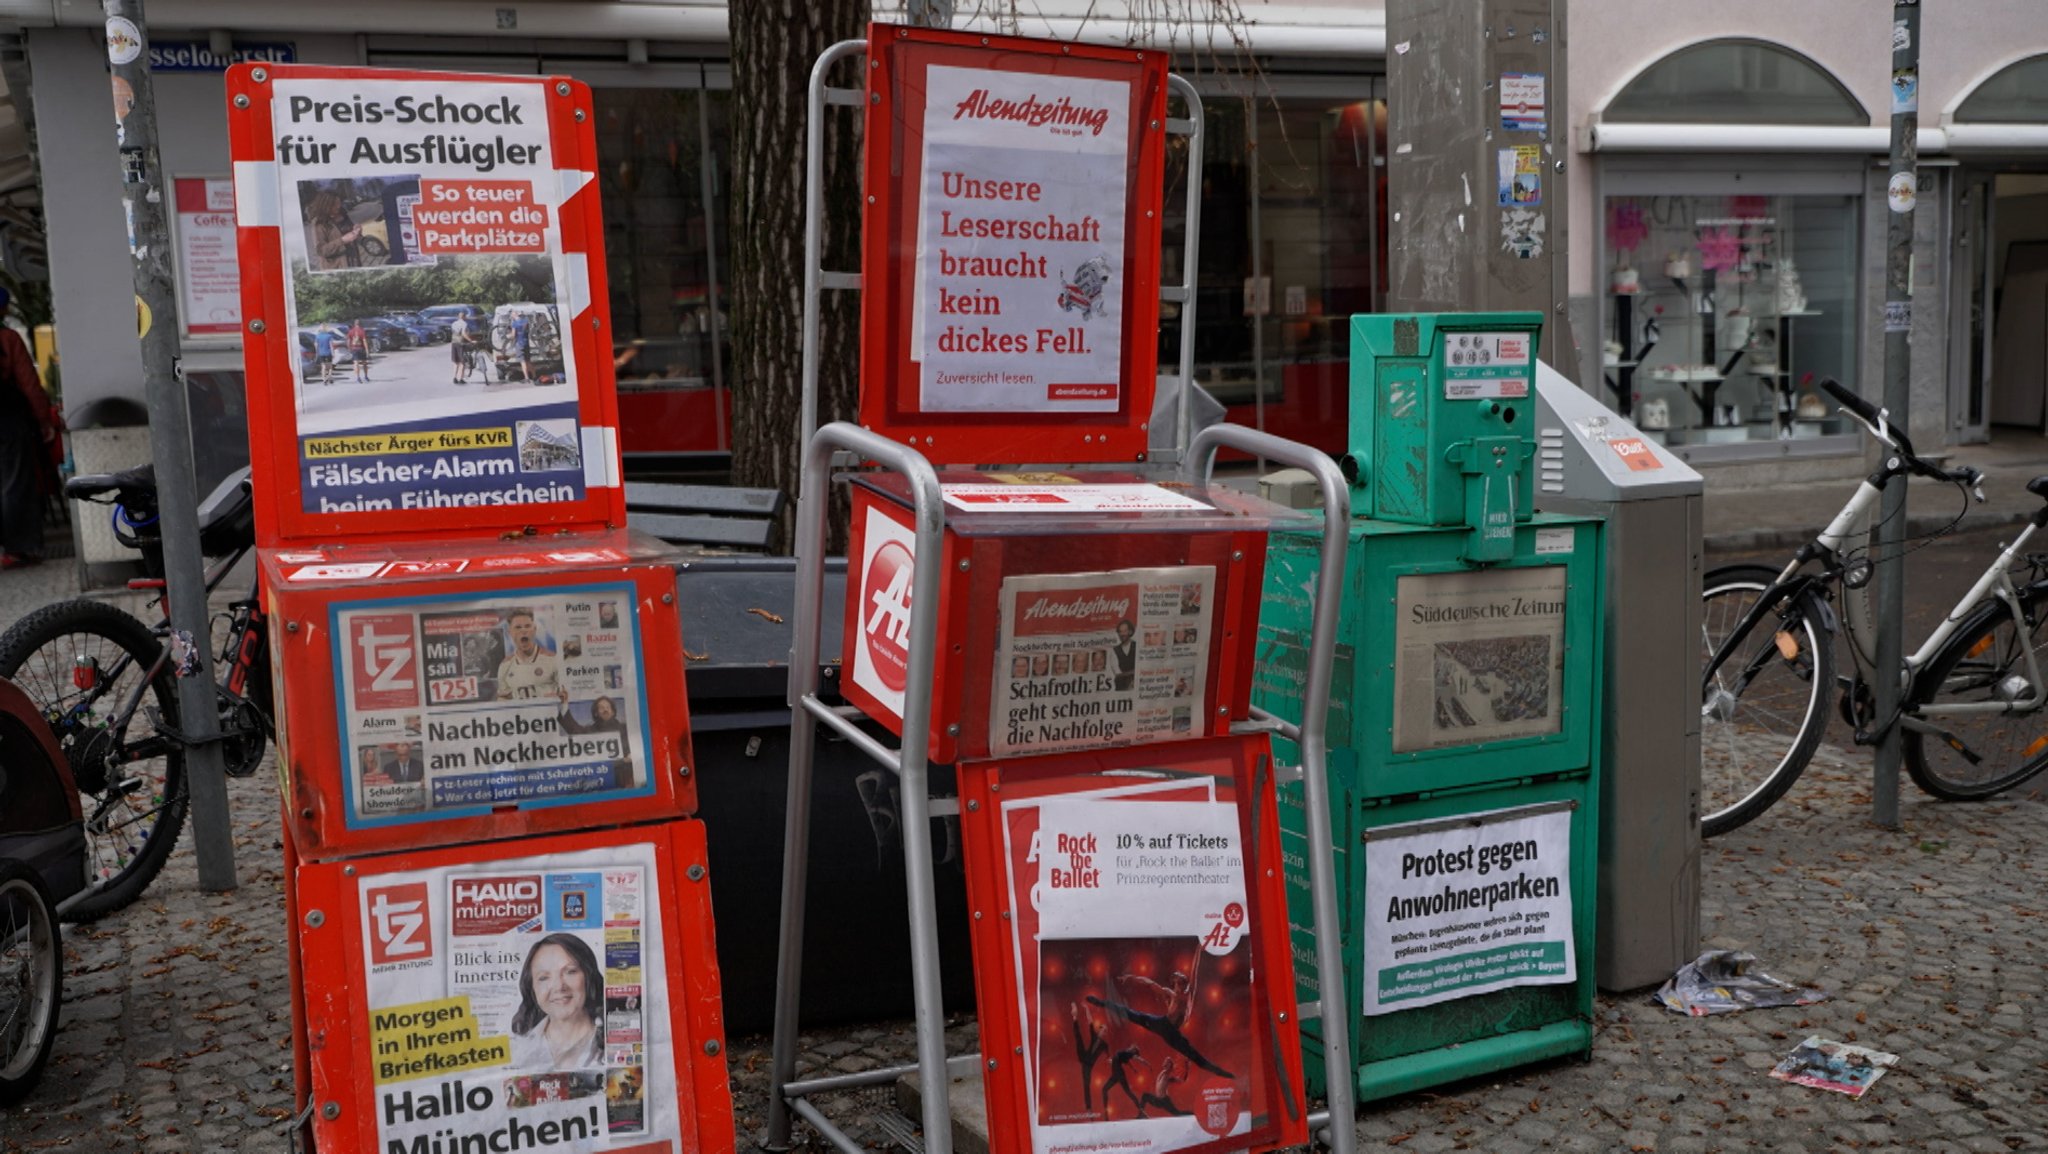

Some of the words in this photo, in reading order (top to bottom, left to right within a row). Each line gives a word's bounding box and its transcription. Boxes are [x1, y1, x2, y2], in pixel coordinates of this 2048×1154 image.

[290, 94, 524, 125] Preis-Schock
[953, 89, 1109, 136] Abendzeitung
[277, 134, 337, 166] für
[350, 134, 541, 172] Ausflügler
[432, 185, 460, 202] So
[465, 186, 525, 202] teuer
[942, 172, 1041, 201] Unsere
[418, 207, 503, 225] werden
[510, 205, 542, 225] die
[941, 211, 1100, 242] Leserschaft
[425, 229, 541, 251] Parkplätze
[939, 248, 1047, 279] braucht
[939, 288, 1001, 315] kein
[938, 326, 1028, 354] dickes
[1035, 327, 1091, 354] Fell.
[936, 371, 998, 385] Zuversicht
[1002, 371, 1036, 385] lesen.
[309, 439, 383, 456] Nächster
[388, 435, 433, 451] Ärger
[439, 433, 470, 447] fürs
[475, 431, 508, 445] KVR
[309, 455, 514, 487] Fälscher-Alarm
[320, 494, 392, 514] beim
[402, 481, 574, 510] Führerschein
[566, 602, 591, 613] Putin
[1024, 594, 1129, 621] Abendzeitung
[1412, 602, 1510, 624] Süddeutsche
[427, 642, 458, 659] Mia
[586, 634, 617, 643] Razzia
[1063, 640, 1075, 649] mit
[358, 624, 414, 691] tz
[428, 662, 457, 676] san
[566, 665, 600, 676] Parken
[431, 677, 477, 700] 125!
[1010, 676, 1092, 700] Schafroth:
[1096, 674, 1112, 691] Es
[363, 717, 396, 728] Alarm
[1008, 702, 1047, 728] geht
[1052, 700, 1100, 719] schon
[1106, 699, 1133, 713] um
[428, 715, 557, 742] Nachbeben
[1007, 726, 1034, 745] die
[1039, 720, 1123, 742] Nachfolge
[431, 752, 466, 770] am
[474, 737, 620, 766] Nockherberg
[444, 778, 482, 789] tz-Leser
[487, 774, 524, 785] rechnen
[528, 771, 544, 781] mit
[547, 766, 593, 779] Schafroth
[597, 765, 608, 774] ab
[475, 789, 492, 800] das
[494, 786, 517, 799] jetzt
[520, 784, 533, 795] für
[537, 782, 555, 793] den
[1058, 832, 1096, 853] Rock
[1149, 833, 1172, 849] auf
[1176, 833, 1228, 850] Tickets
[1070, 852, 1092, 869] the
[1116, 856, 1132, 868] für
[1170, 855, 1187, 868] the
[1227, 856, 1241, 867] im
[1402, 844, 1474, 879] Protest
[1478, 839, 1537, 875] gegen
[1051, 868, 1099, 889] Ballet
[1117, 872, 1230, 888] Prinzregententheater
[1387, 872, 1559, 923] Anwohnerparken
[456, 902, 538, 919] münchen
[1484, 916, 1507, 928] wehren
[1508, 912, 1522, 923] sich
[1525, 910, 1549, 923] gegen
[372, 894, 425, 957] tz
[1395, 946, 1428, 960] geplante
[1480, 932, 1491, 943] die
[1492, 930, 1502, 940] die
[1504, 925, 1522, 937] Stadt
[1524, 924, 1545, 936] plant
[372, 965, 396, 974] MEHR
[398, 960, 433, 970] ZEITUNG
[454, 951, 492, 966] Blick
[498, 950, 521, 963] ins
[454, 969, 519, 984] Innerste
[1462, 973, 1472, 982] der
[1538, 961, 1565, 972] Bayern
[375, 1005, 463, 1031] Morgen
[378, 1039, 399, 1055] in
[407, 1028, 471, 1050] Ihrem
[380, 1045, 504, 1079] Briefkasten
[384, 1080, 493, 1126] Hallo
[388, 1106, 599, 1154] München!
